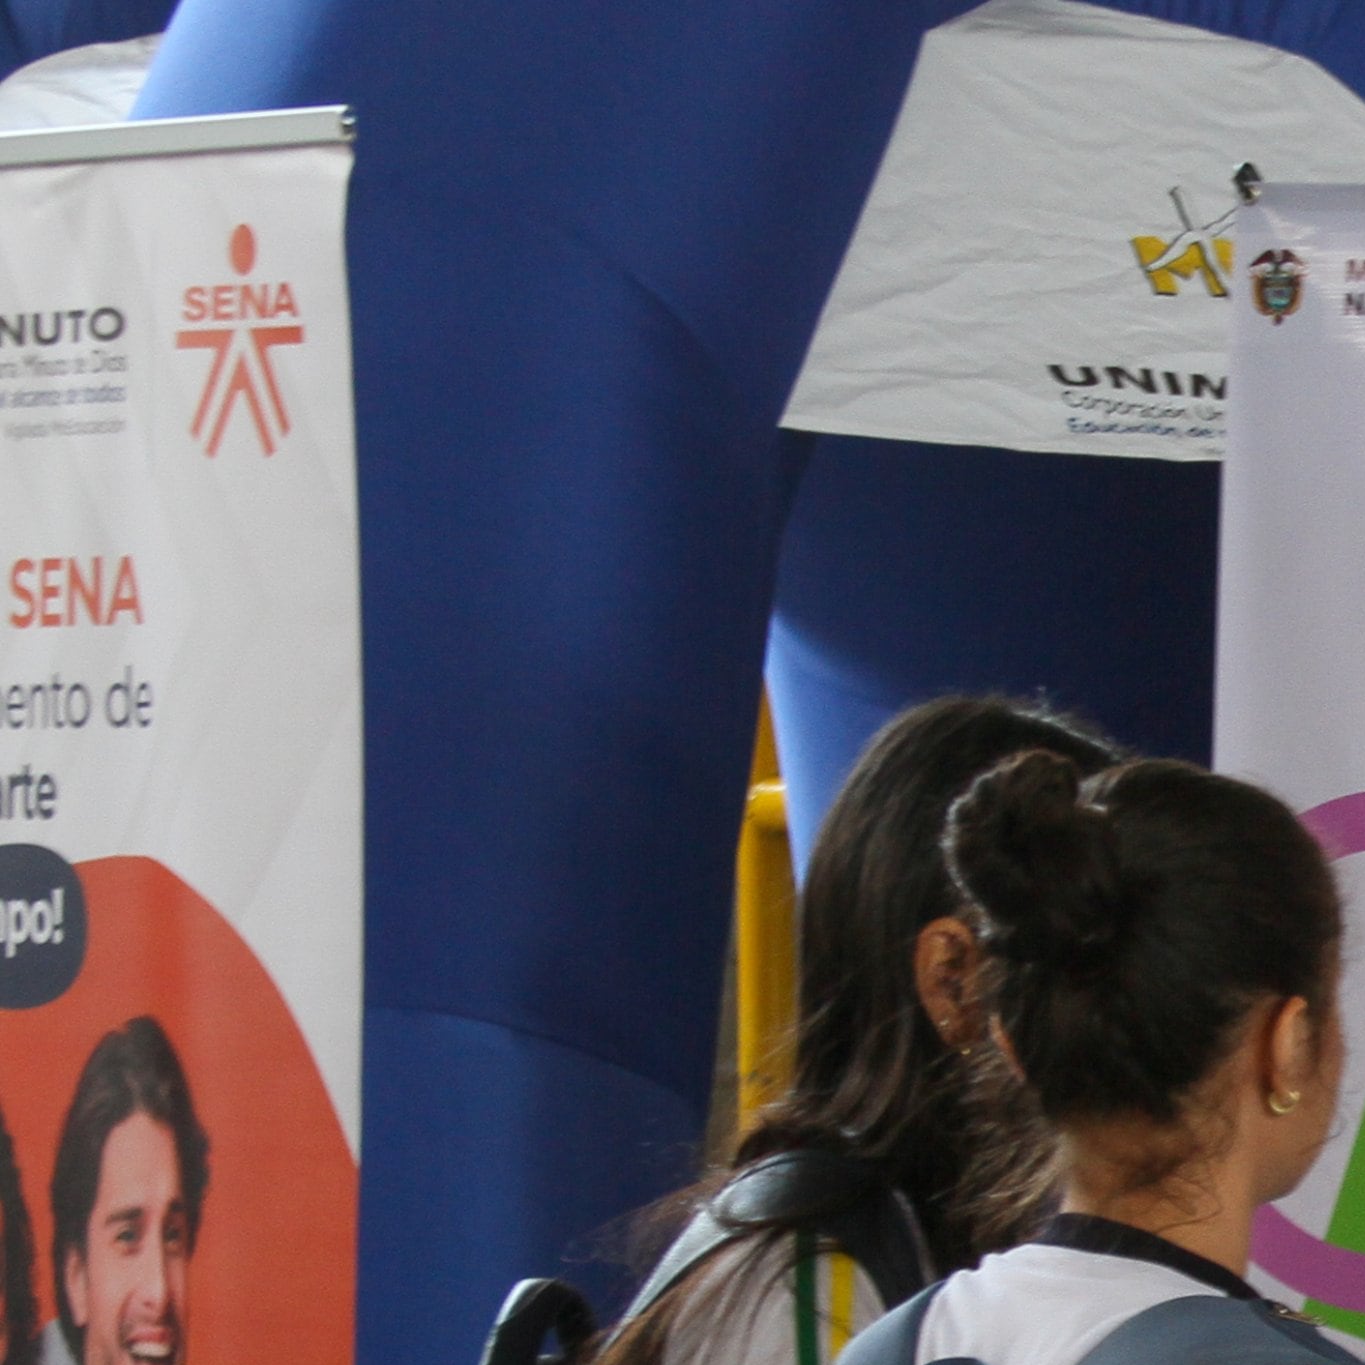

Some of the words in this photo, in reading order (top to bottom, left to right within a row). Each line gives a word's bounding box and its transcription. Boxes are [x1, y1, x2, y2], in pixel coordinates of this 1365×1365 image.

[182, 281, 300, 322] SENA
[8, 555, 144, 629] SENA
[105, 664, 153, 729] de
